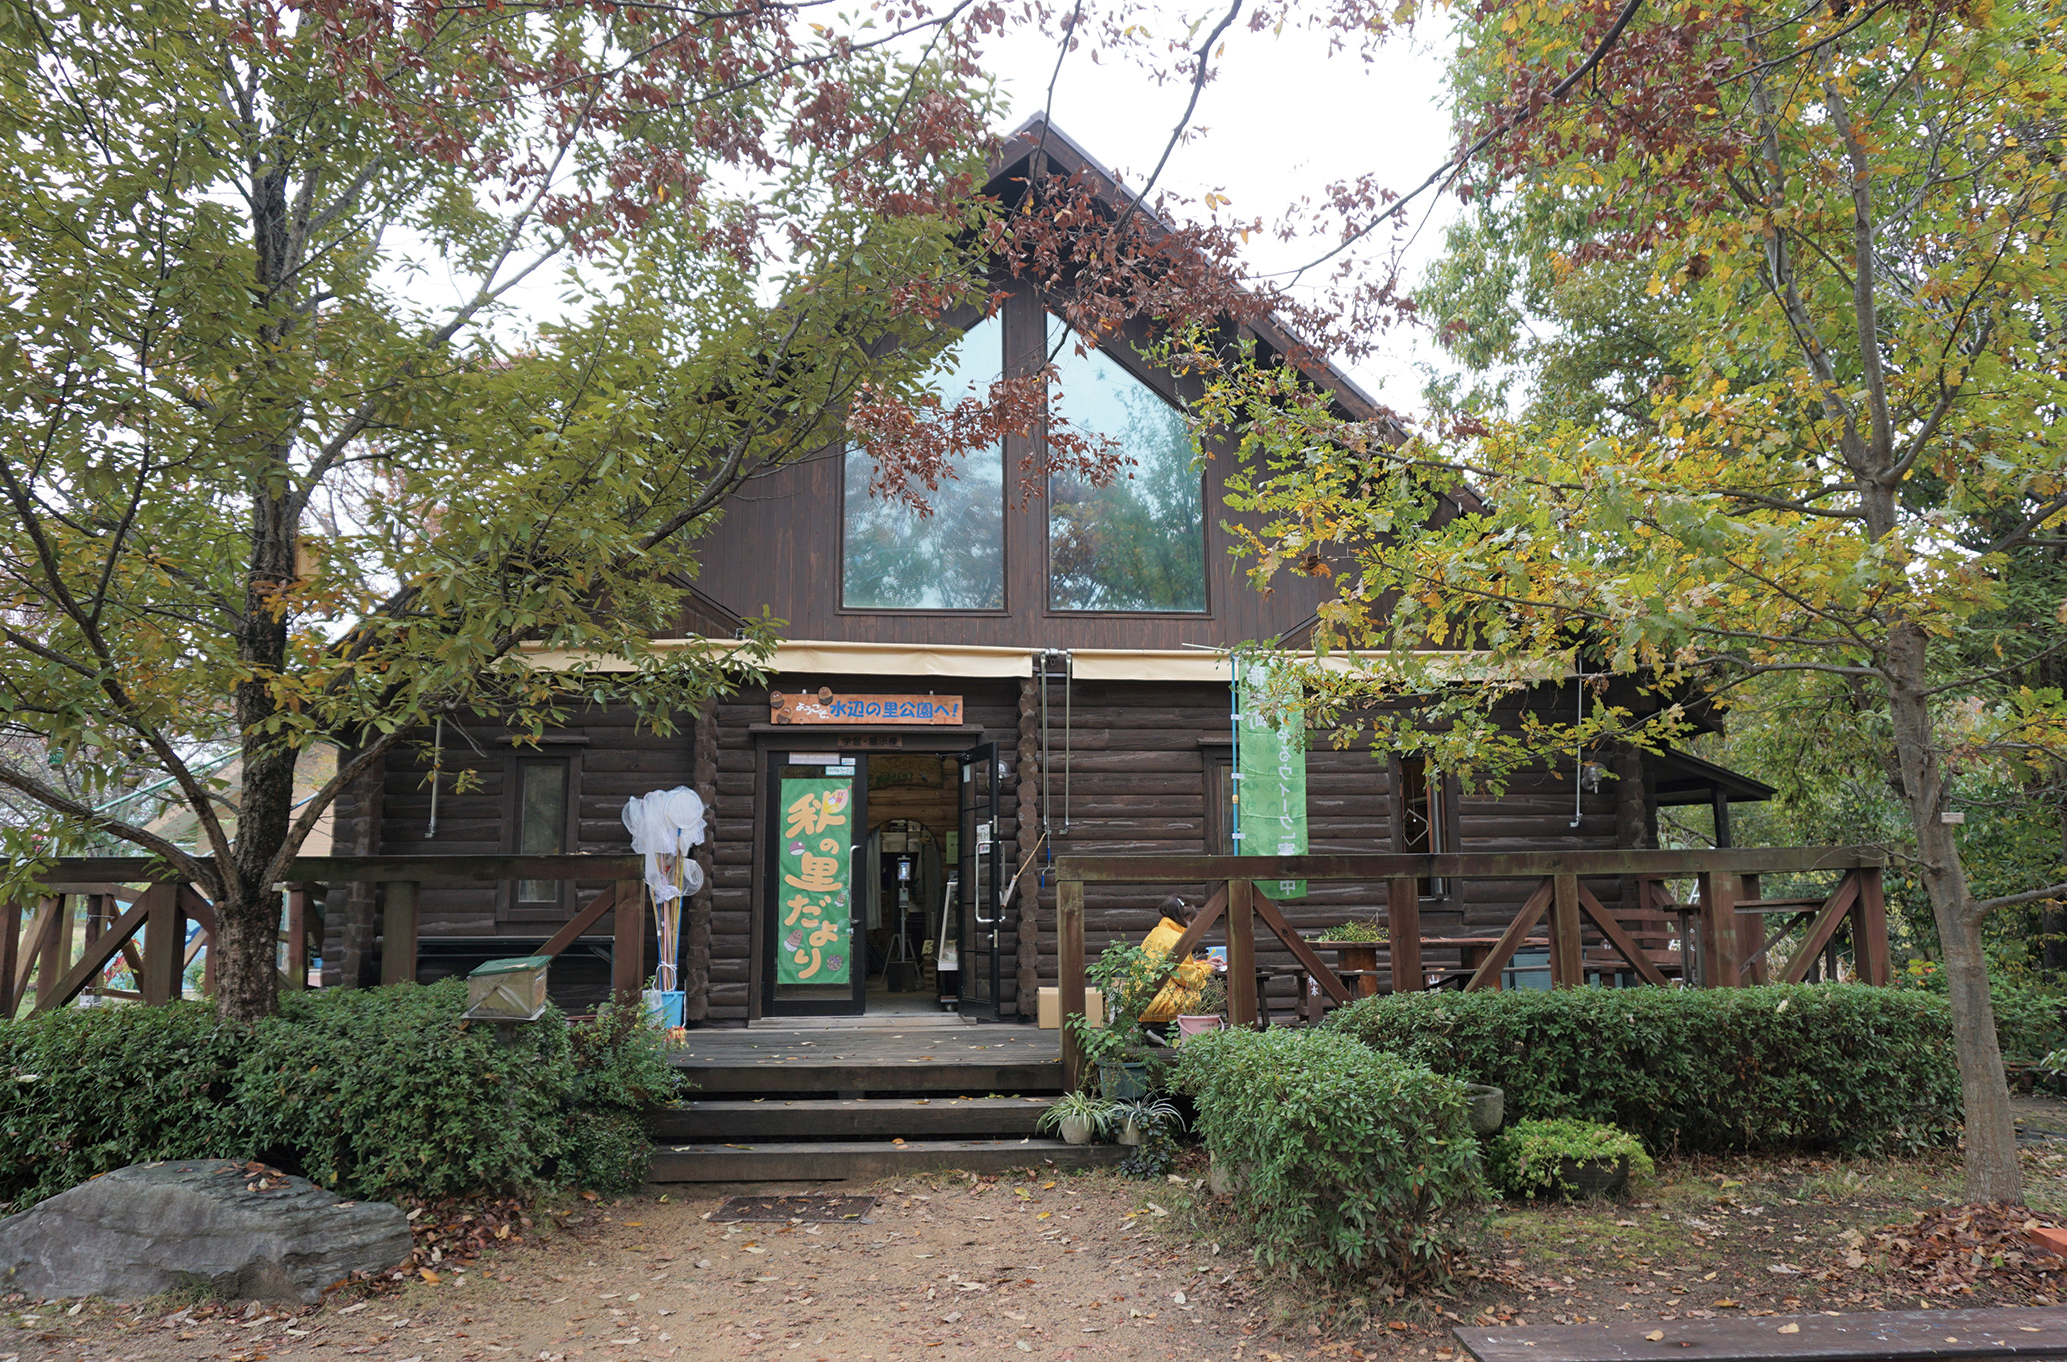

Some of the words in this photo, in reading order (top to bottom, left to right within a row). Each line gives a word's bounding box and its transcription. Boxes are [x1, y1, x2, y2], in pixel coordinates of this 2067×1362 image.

[785, 791, 846, 979] 秋の里だより
